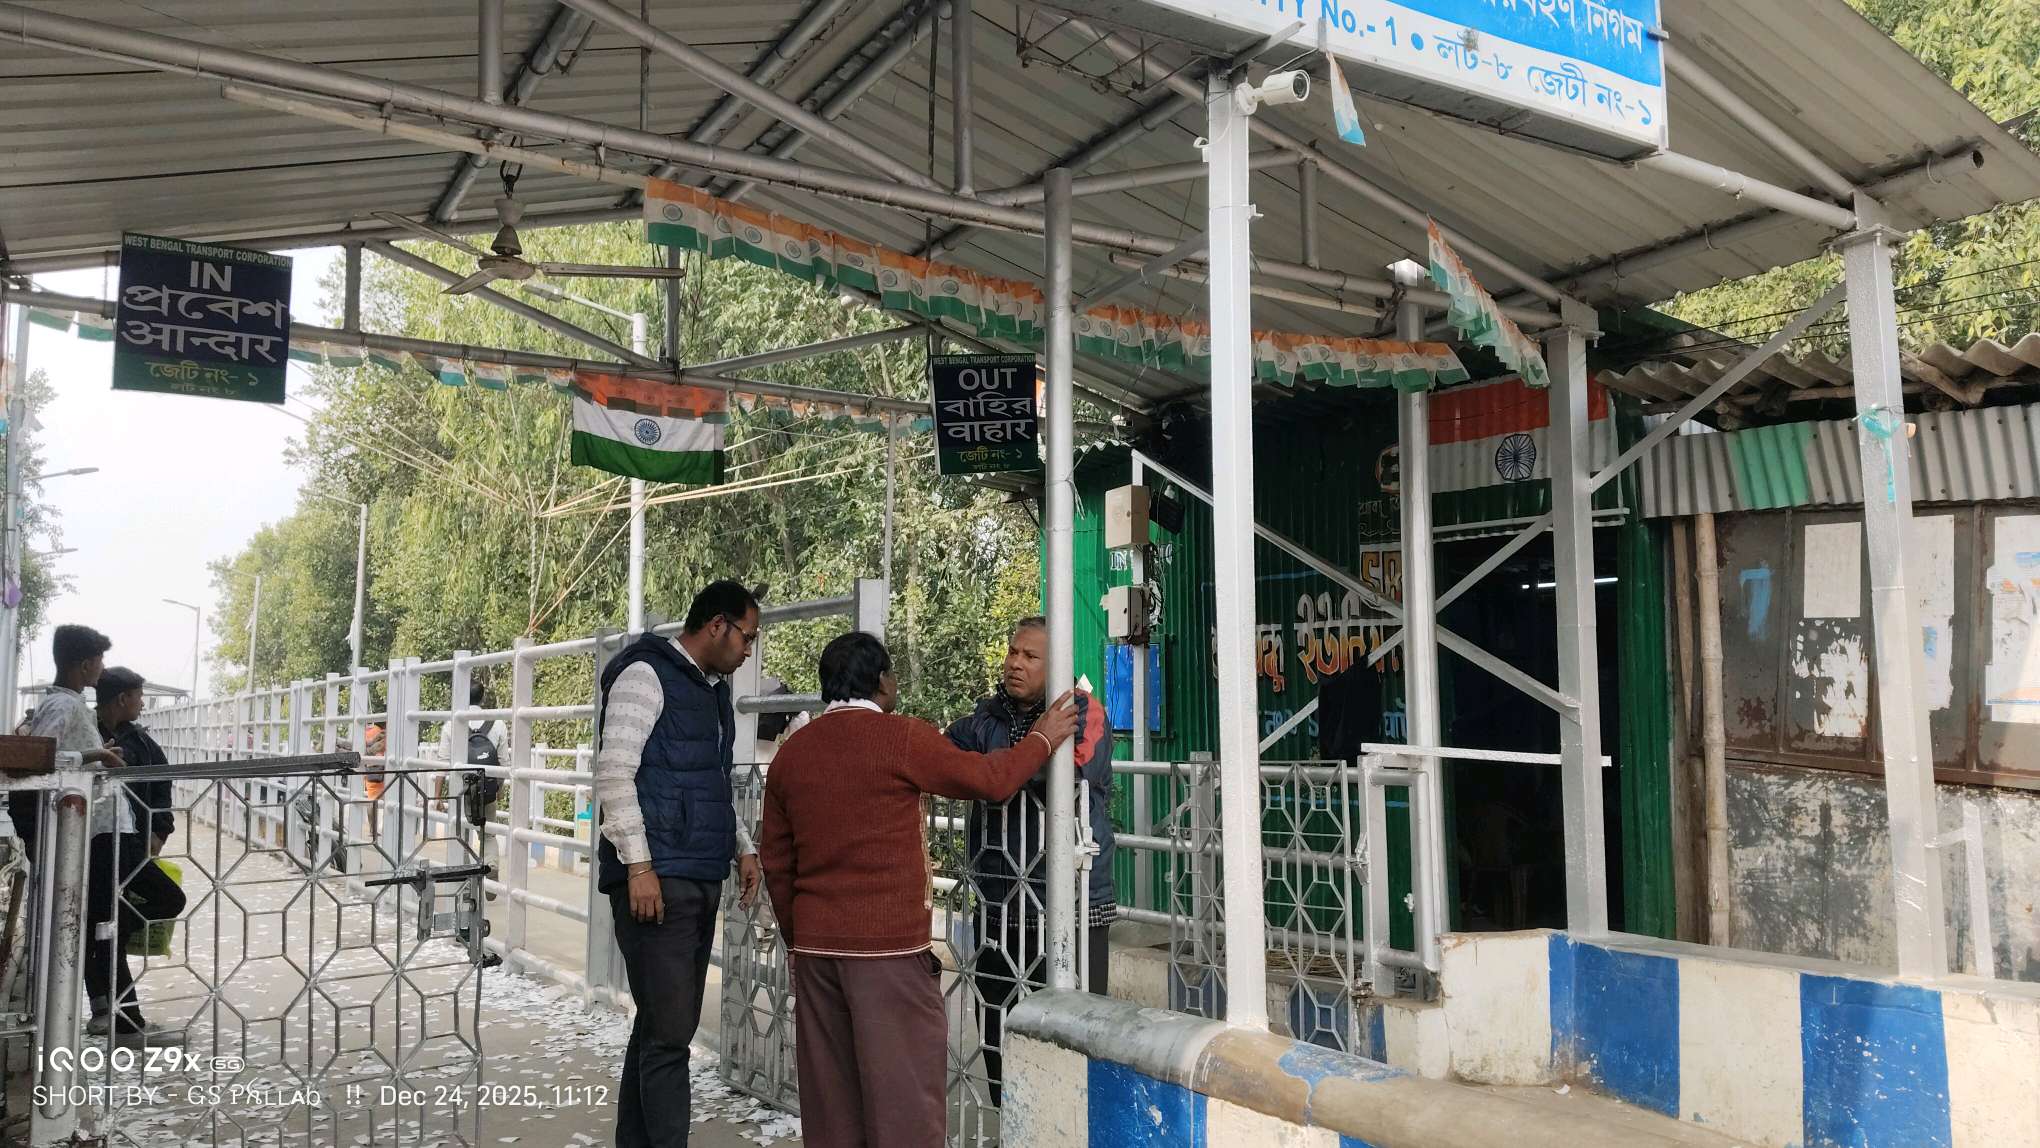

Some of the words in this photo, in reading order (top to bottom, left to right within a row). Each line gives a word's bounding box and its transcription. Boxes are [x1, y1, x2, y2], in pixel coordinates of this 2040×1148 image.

[1527, 62, 1588, 107] জেটী
[124, 235, 149, 248] WEST
[150, 238, 183, 253] BENGAL
[185, 243, 234, 260] TRANSPORT
[236, 250, 292, 268] CORPORATION
[190, 260, 233, 292] IN
[122, 284, 289, 330] প্রবেশ
[144, 359, 201, 381] জেটি
[958, 367, 1017, 390] OUT
[937, 391, 1033, 418] বাহির
